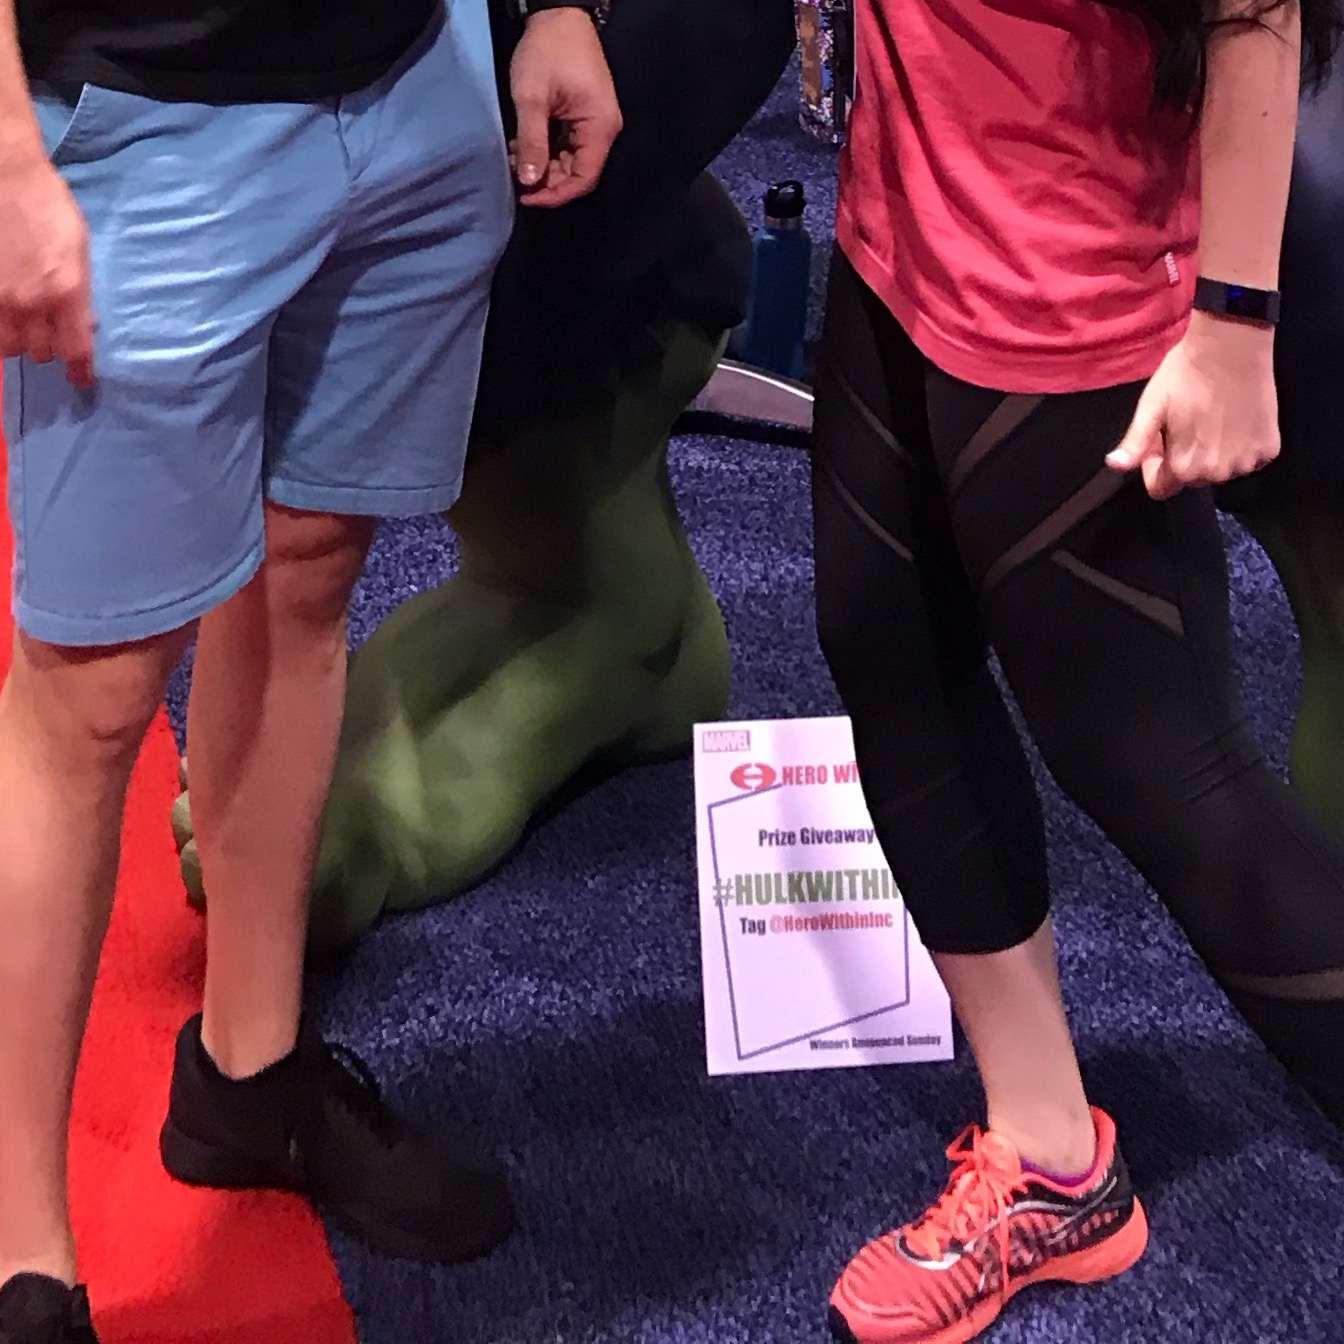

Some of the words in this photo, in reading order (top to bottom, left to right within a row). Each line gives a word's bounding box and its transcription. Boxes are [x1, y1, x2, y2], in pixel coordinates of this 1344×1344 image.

[782, 765, 828, 786] HERO
[758, 828, 797, 847] Prize
[800, 826, 875, 845] Giveaway
[740, 918, 766, 936] Tag
